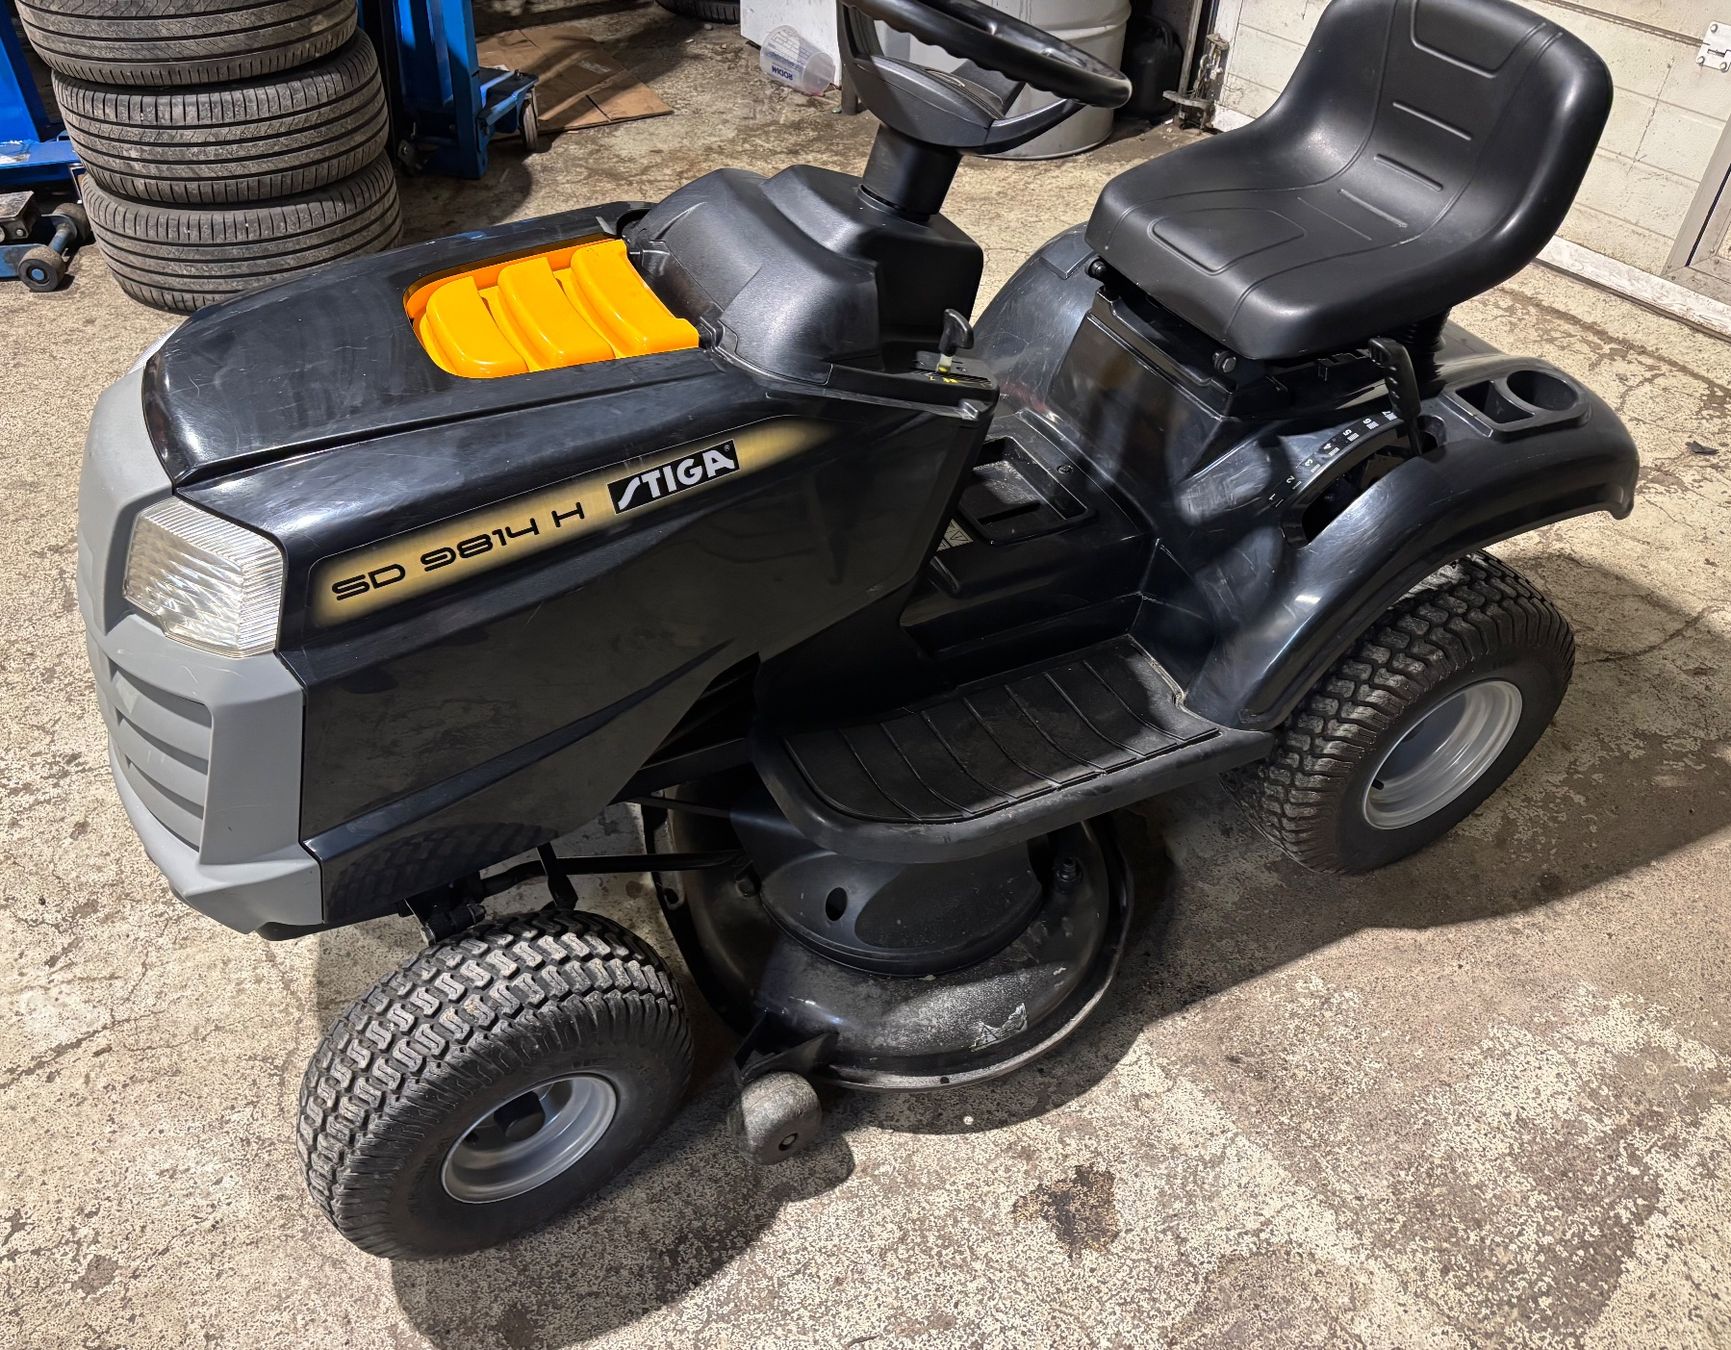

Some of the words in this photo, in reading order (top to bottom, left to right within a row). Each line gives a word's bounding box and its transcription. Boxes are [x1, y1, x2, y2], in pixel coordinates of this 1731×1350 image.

[616, 449, 737, 511] STIGA
[332, 562, 406, 601] SD
[419, 517, 540, 573] 9814
[552, 501, 586, 528] H
